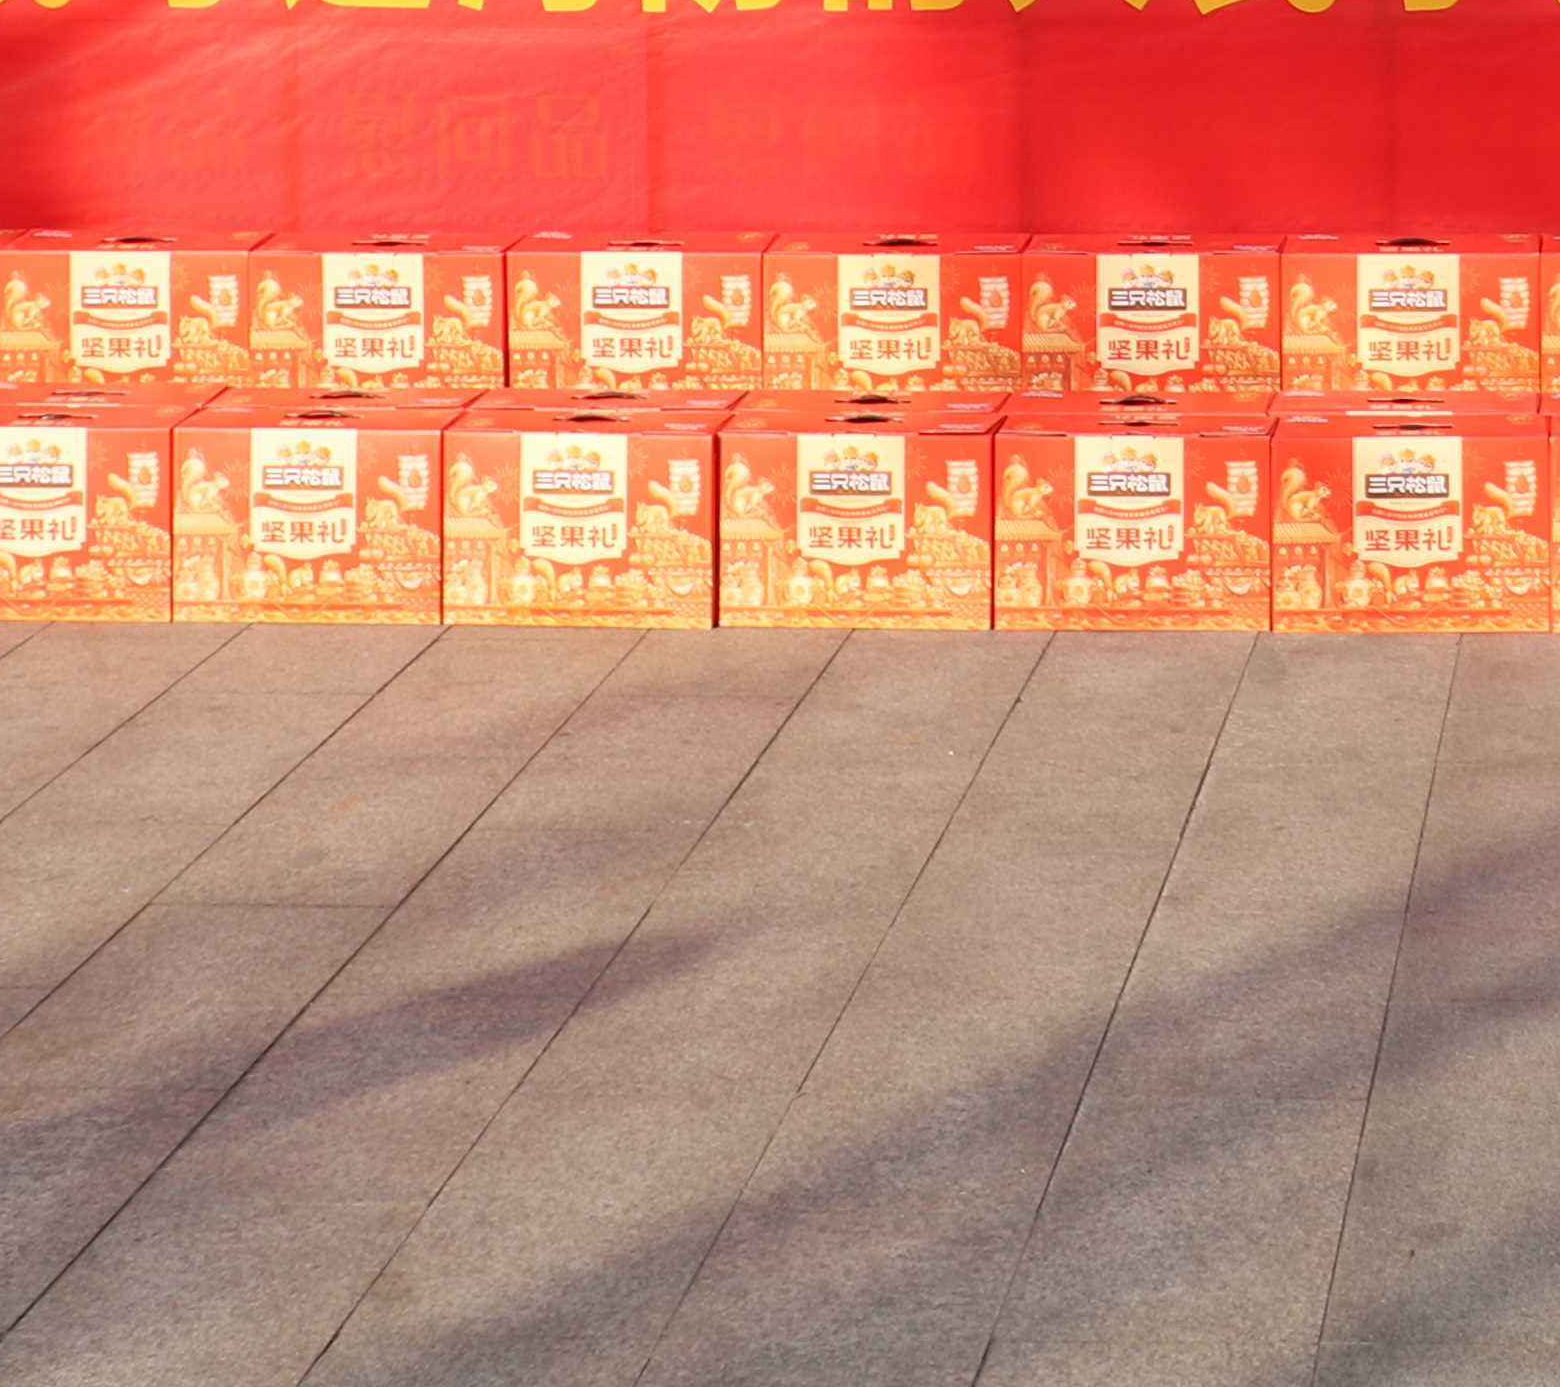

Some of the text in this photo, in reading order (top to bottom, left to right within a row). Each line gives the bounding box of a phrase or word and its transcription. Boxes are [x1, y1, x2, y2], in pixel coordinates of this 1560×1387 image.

[84, 288, 156, 304] 三只松鼠
[336, 288, 410, 305] 三只松鼠
[595, 288, 669, 305] 三只松鼠
[853, 290, 925, 306] 三只松鼠
[1111, 290, 1185, 307] 三只松鼠
[1372, 291, 1446, 308] 三只松鼠
[81, 337, 161, 358] 坚果礼
[334, 337, 414, 358] 坚果礼
[592, 337, 672, 358] 坚果礼
[850, 339, 930, 360] 坚果礼
[1108, 339, 1190, 360] 坚果礼
[1369, 340, 1451, 361] 坚果礼
[265, 468, 342, 486] 三只松鼠
[535, 472, 612, 490] 三只松鼠
[812, 473, 891, 491] 三只松鼠
[1090, 474, 1169, 492] 三只松鼠
[1368, 476, 1447, 494] 三只松鼠
[262, 521, 345, 543] 坚果礼
[531, 525, 616, 547] 坚果礼
[809, 526, 894, 548] 坚果礼
[1086, 527, 1173, 550] 坚果礼
[1364, 528, 1453, 552] 坚果礼
